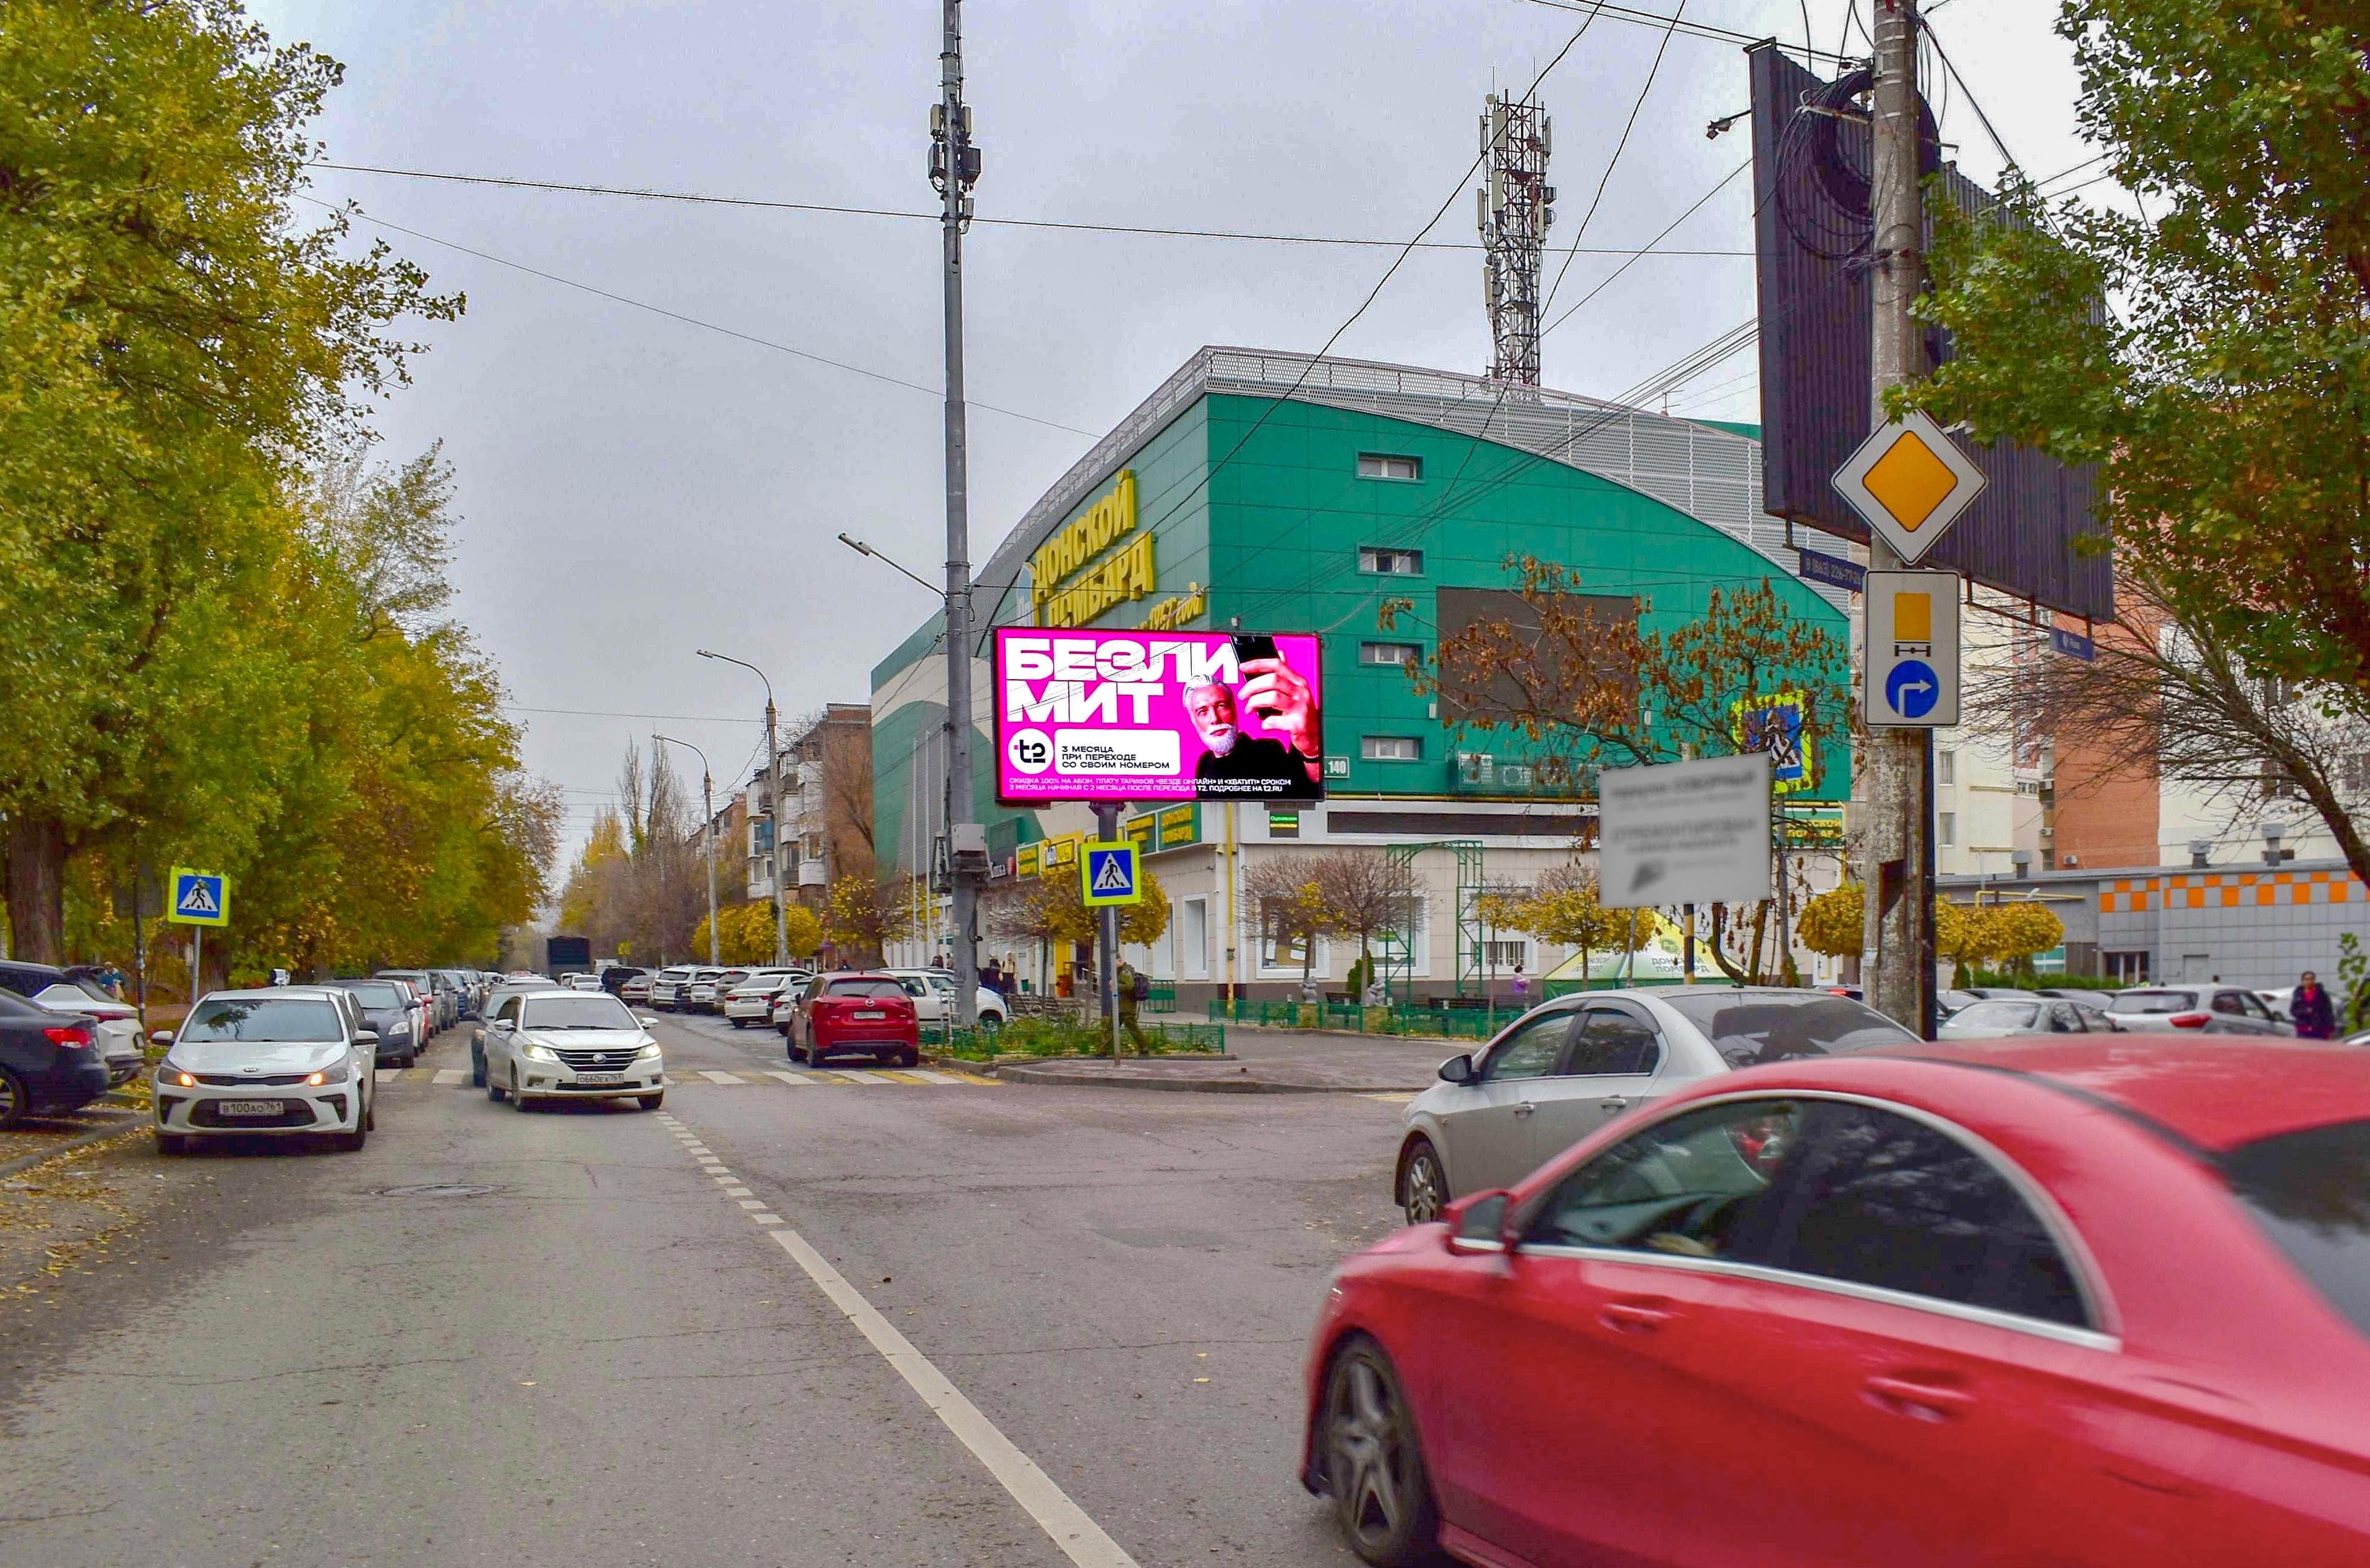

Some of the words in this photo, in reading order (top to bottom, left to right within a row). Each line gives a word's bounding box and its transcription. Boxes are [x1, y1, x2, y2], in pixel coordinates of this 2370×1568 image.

[1035, 469, 1136, 604] ДОНСКОЙ
[1048, 531, 1155, 628] ЛОМБАРД
[1006, 637, 1239, 684] БЕЗЛИ
[1006, 680, 1165, 725] МИТ
[1014, 739, 1046, 764] t2
[1328, 761, 1346, 774] 140
